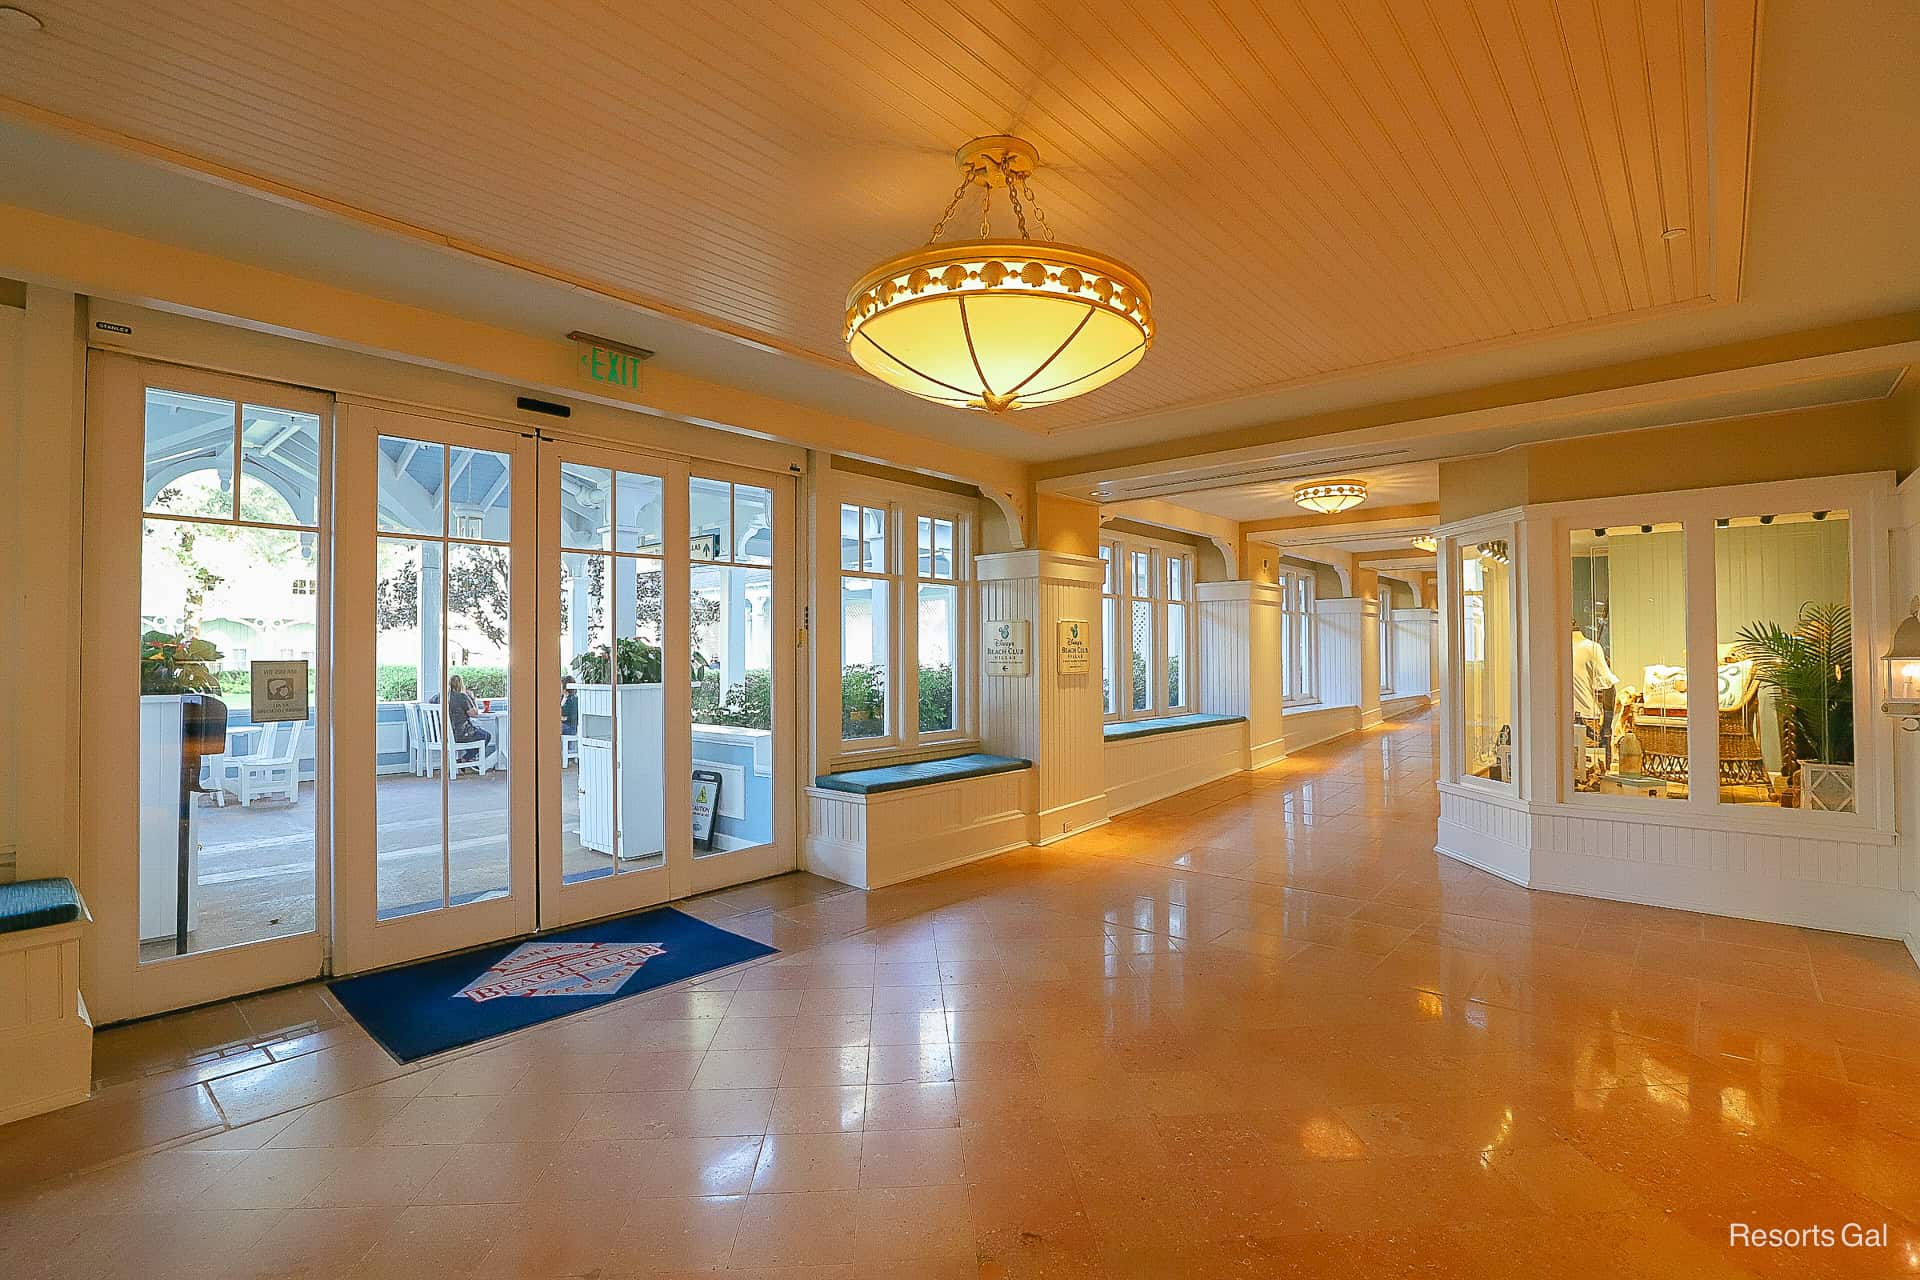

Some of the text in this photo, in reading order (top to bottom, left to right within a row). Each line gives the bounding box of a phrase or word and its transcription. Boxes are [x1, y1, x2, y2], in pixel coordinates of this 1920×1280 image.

[591, 347, 641, 390] EXIT
[987, 647, 1007, 655] BEACH
[1061, 646, 1089, 654] BEACH CLUB
[472, 945, 660, 1000] BEACH CLUB
